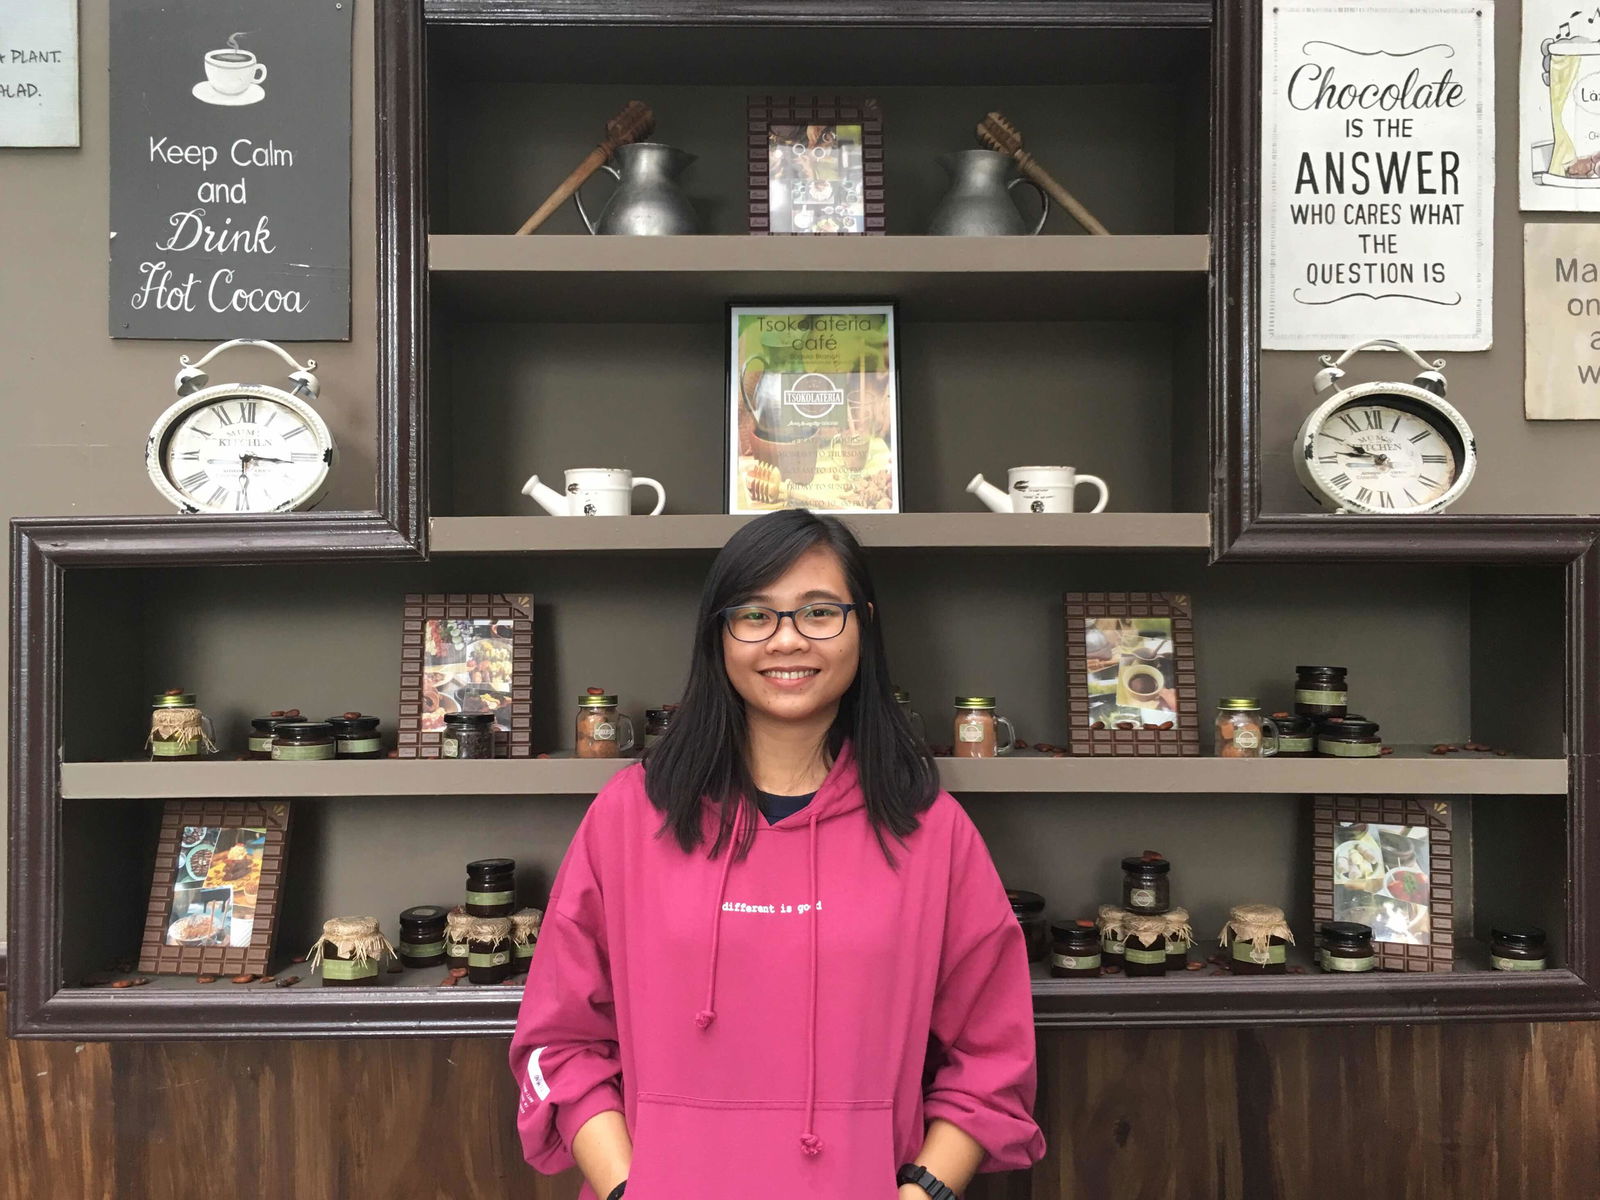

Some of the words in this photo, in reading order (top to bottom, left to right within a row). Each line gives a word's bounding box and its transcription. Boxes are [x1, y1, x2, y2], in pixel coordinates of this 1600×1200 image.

[11, 49, 62, 64] PLANT.
[1287, 63, 1466, 112] Chocolate
[1345, 118, 1363, 138] IS
[1373, 118, 1414, 138] THE
[149, 136, 218, 171] Keep
[231, 139, 293, 167] Calm
[1294, 150, 1460, 195] ANSWER
[197, 178, 247, 204] and
[1290, 203, 1336, 225] WHO
[1343, 203, 1402, 225] CARES
[1409, 203, 1465, 225] WHAT
[155, 207, 276, 254] Drink
[1358, 233, 1398, 254] THE
[1306, 262, 1414, 286] QUESTION
[1423, 262, 1446, 284] IS
[131, 261, 202, 313] Hot
[207, 268, 310, 313] Cocoa
[757, 315, 872, 332] Tsokolateria
[791, 334, 838, 351] café
[787, 392, 841, 403] TSOKOLATERIA
[238, 402, 258, 424] XII
[1362, 409, 1384, 430] XII
[721, 902, 776, 914] different
[780, 903, 793, 914] is
[796, 900, 823, 915] god
